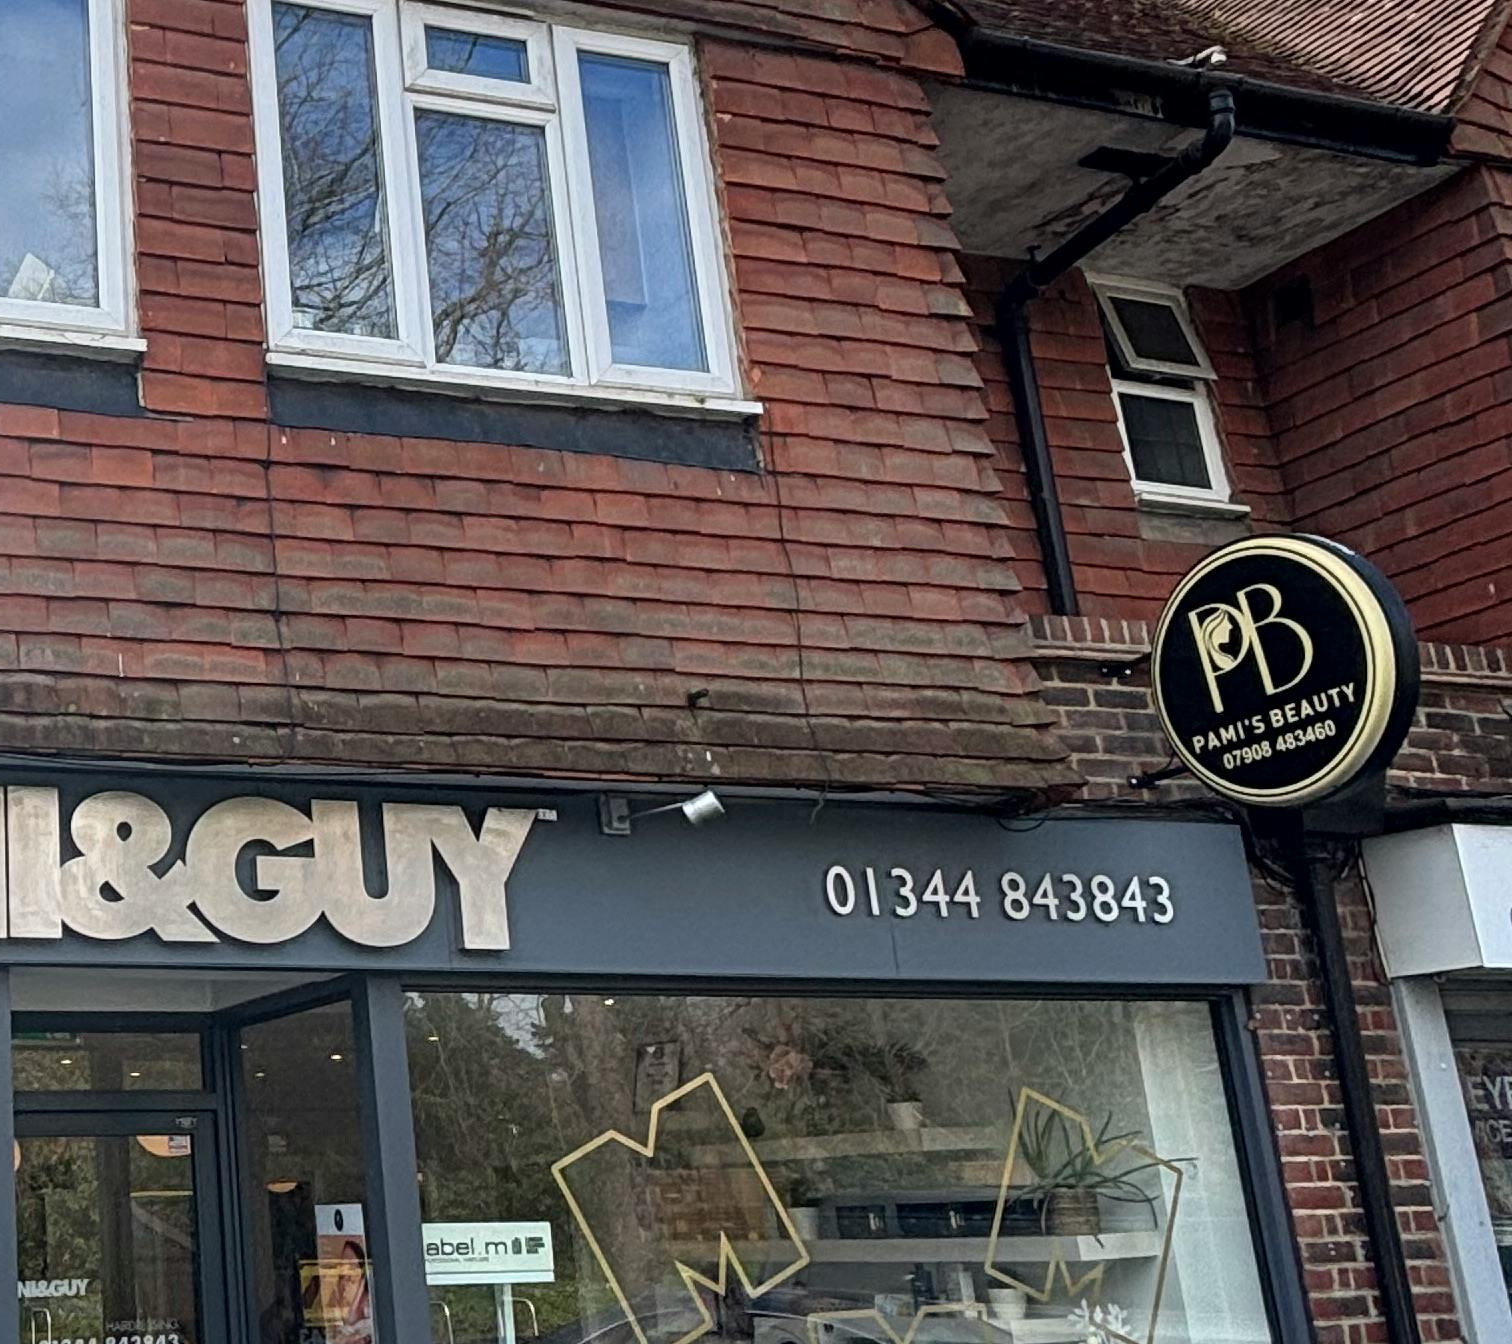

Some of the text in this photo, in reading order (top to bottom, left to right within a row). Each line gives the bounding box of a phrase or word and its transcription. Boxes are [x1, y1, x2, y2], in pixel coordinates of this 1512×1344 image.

[1192, 682, 1356, 754] PAMI'S BEAUTY
[1223, 719, 1337, 770] 07908 483460
[825, 864, 1175, 925] 01344 843843
[426, 1237, 508, 1256] abel.m
[18, 1278, 90, 1298] NI&GUY
